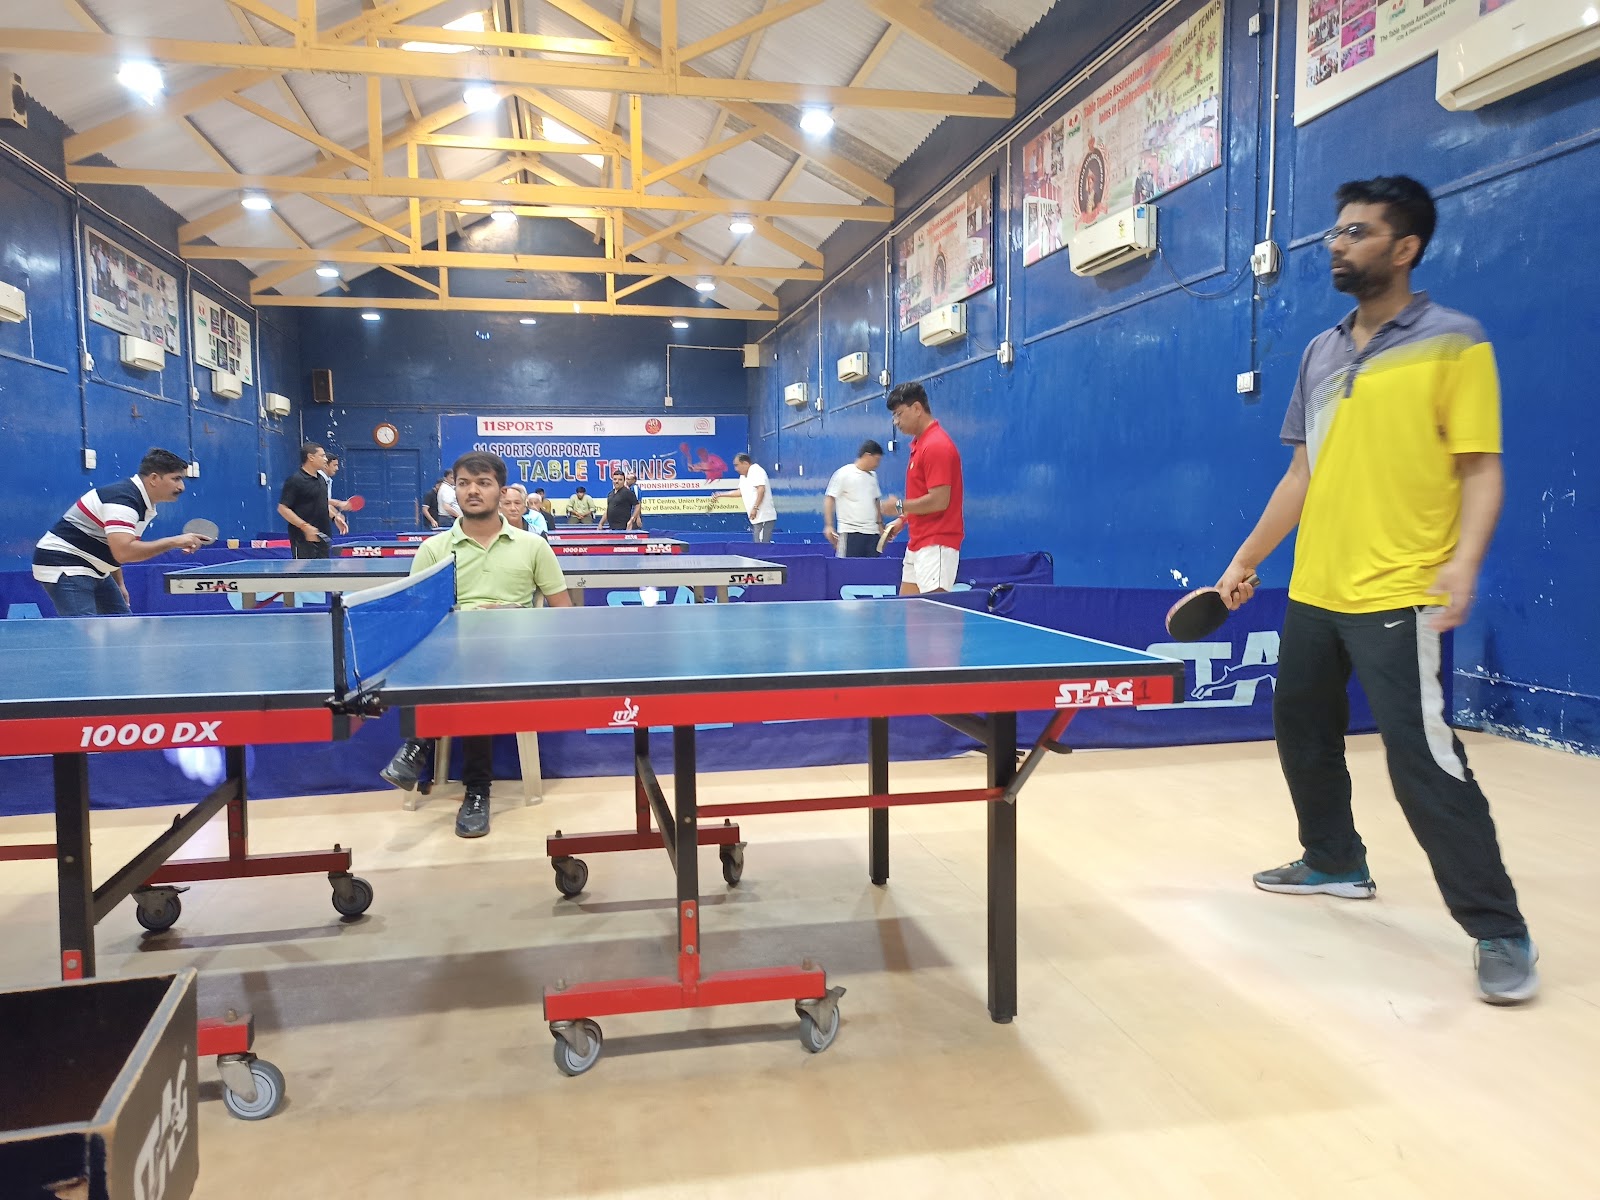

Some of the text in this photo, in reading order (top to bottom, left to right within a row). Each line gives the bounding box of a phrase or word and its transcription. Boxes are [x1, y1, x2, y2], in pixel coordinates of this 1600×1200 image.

[1416, 4, 1442, 22] Association
[1183, 25, 1197, 49] TABLE
[1198, 0, 1221, 31] TENNIS
[489, 444, 533, 456] SPORTS
[536, 444, 599, 456] CORPORATE
[519, 459, 676, 480] TABLE TENNIS
[640, 482, 700, 490] PIONSHIPS-2018
[352, 547, 382, 556] STAG
[645, 544, 672, 554] STAG
[729, 573, 764, 585] STAG
[195, 580, 238, 592] STAG
[1055, 679, 1133, 708] STAG
[80, 720, 222, 748] 1000 DX
